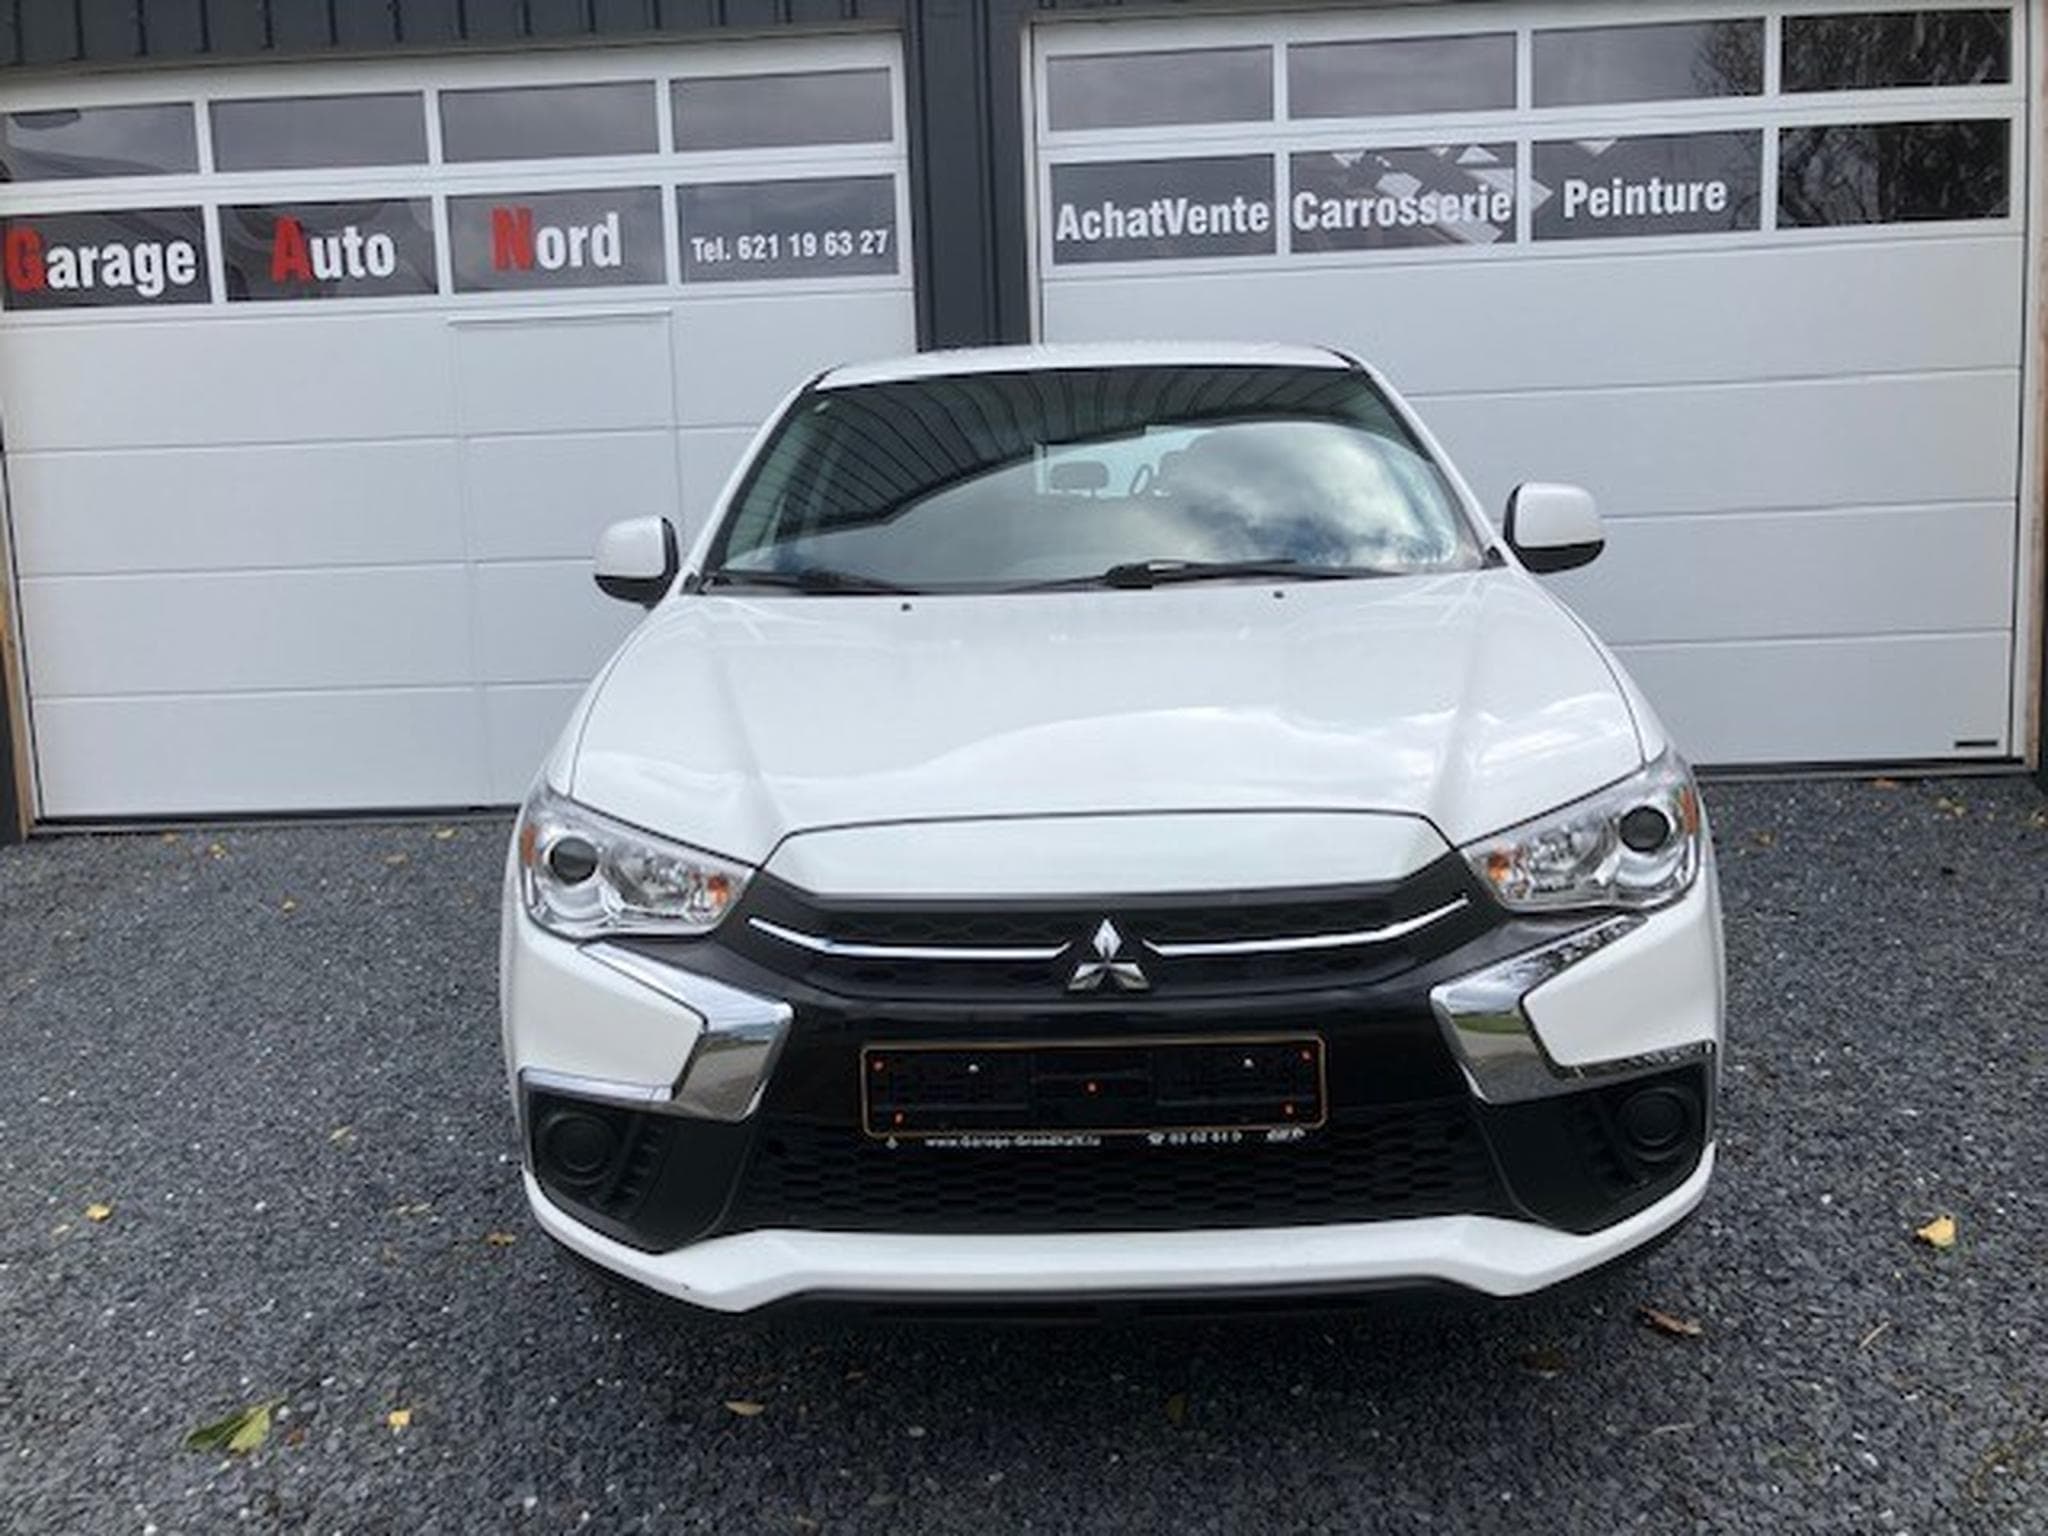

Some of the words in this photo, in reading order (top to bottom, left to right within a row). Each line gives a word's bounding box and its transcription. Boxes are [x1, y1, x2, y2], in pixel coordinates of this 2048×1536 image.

[1056, 196, 1270, 242] AchatVente
[1293, 184, 1512, 232] Carrosserie
[1563, 178, 1728, 218] Peinture
[4, 226, 198, 297] Garage
[271, 214, 397, 283] Auto
[491, 206, 622, 273] Nord
[691, 236, 732, 263] Tel.
[738, 234, 779, 259] 621
[789, 232, 816, 258] 19
[824, 231, 853, 257] 63
[859, 229, 888, 255] 27
